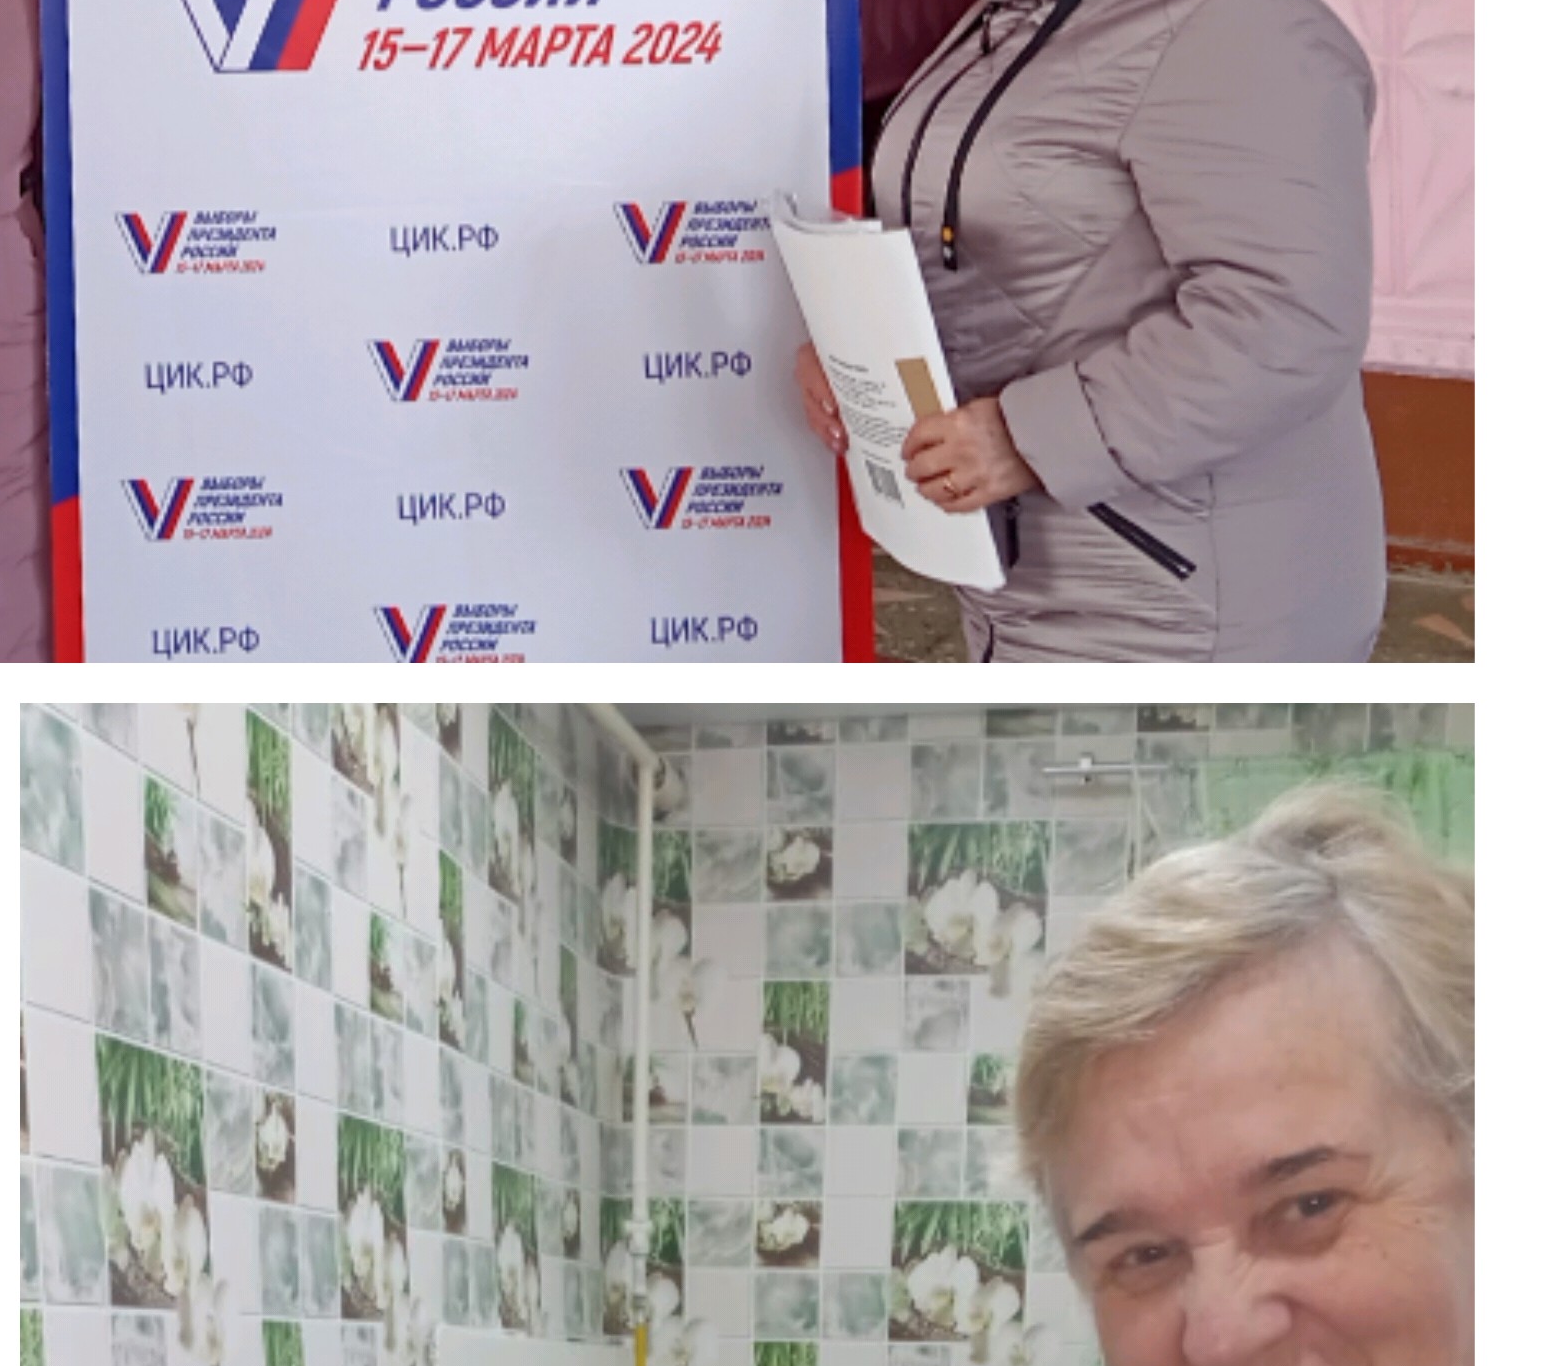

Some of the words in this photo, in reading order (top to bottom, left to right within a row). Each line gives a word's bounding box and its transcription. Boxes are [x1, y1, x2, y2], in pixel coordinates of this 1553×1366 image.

[475, 23, 617, 69] МАРТА
[620, 21, 723, 65] 2024
[390, 225, 499, 254] ЦИК.РФ
[145, 361, 253, 392] ЦИК.РФ
[644, 352, 752, 382] ЦИК.РФ
[398, 492, 506, 525] ЦИК.РФ
[152, 627, 260, 659] ЦИК.РФ
[650, 616, 758, 648] ЦИК.РФ
